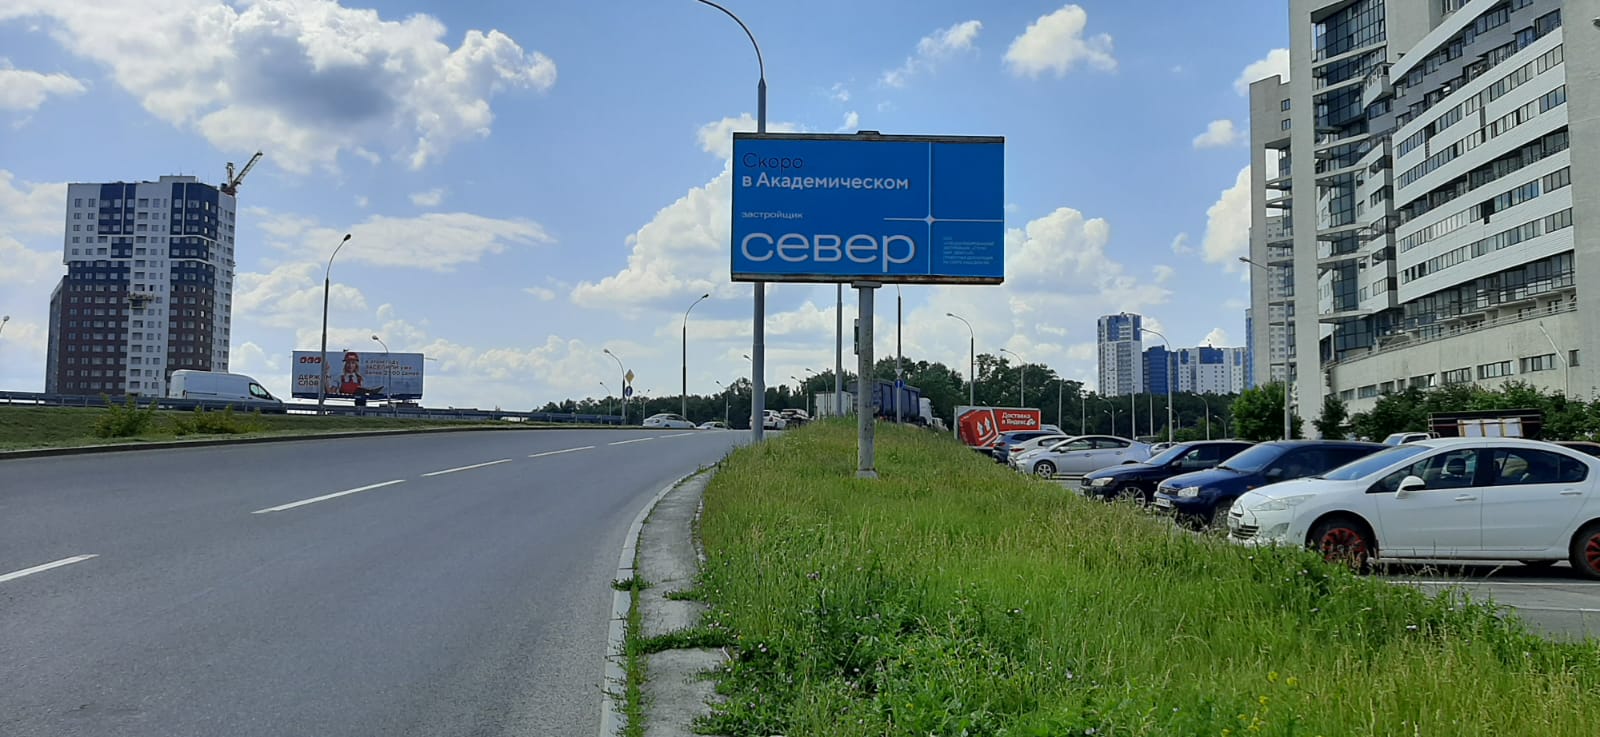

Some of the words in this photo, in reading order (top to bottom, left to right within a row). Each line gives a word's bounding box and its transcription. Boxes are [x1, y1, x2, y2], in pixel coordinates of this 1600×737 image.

[743, 152, 803, 174] Скоро
[742, 175, 752, 187] в
[756, 172, 909, 190] Академическом
[742, 210, 803, 220] застройщик
[741, 232, 915, 272] север
[1002, 411, 1031, 419] Доставка
